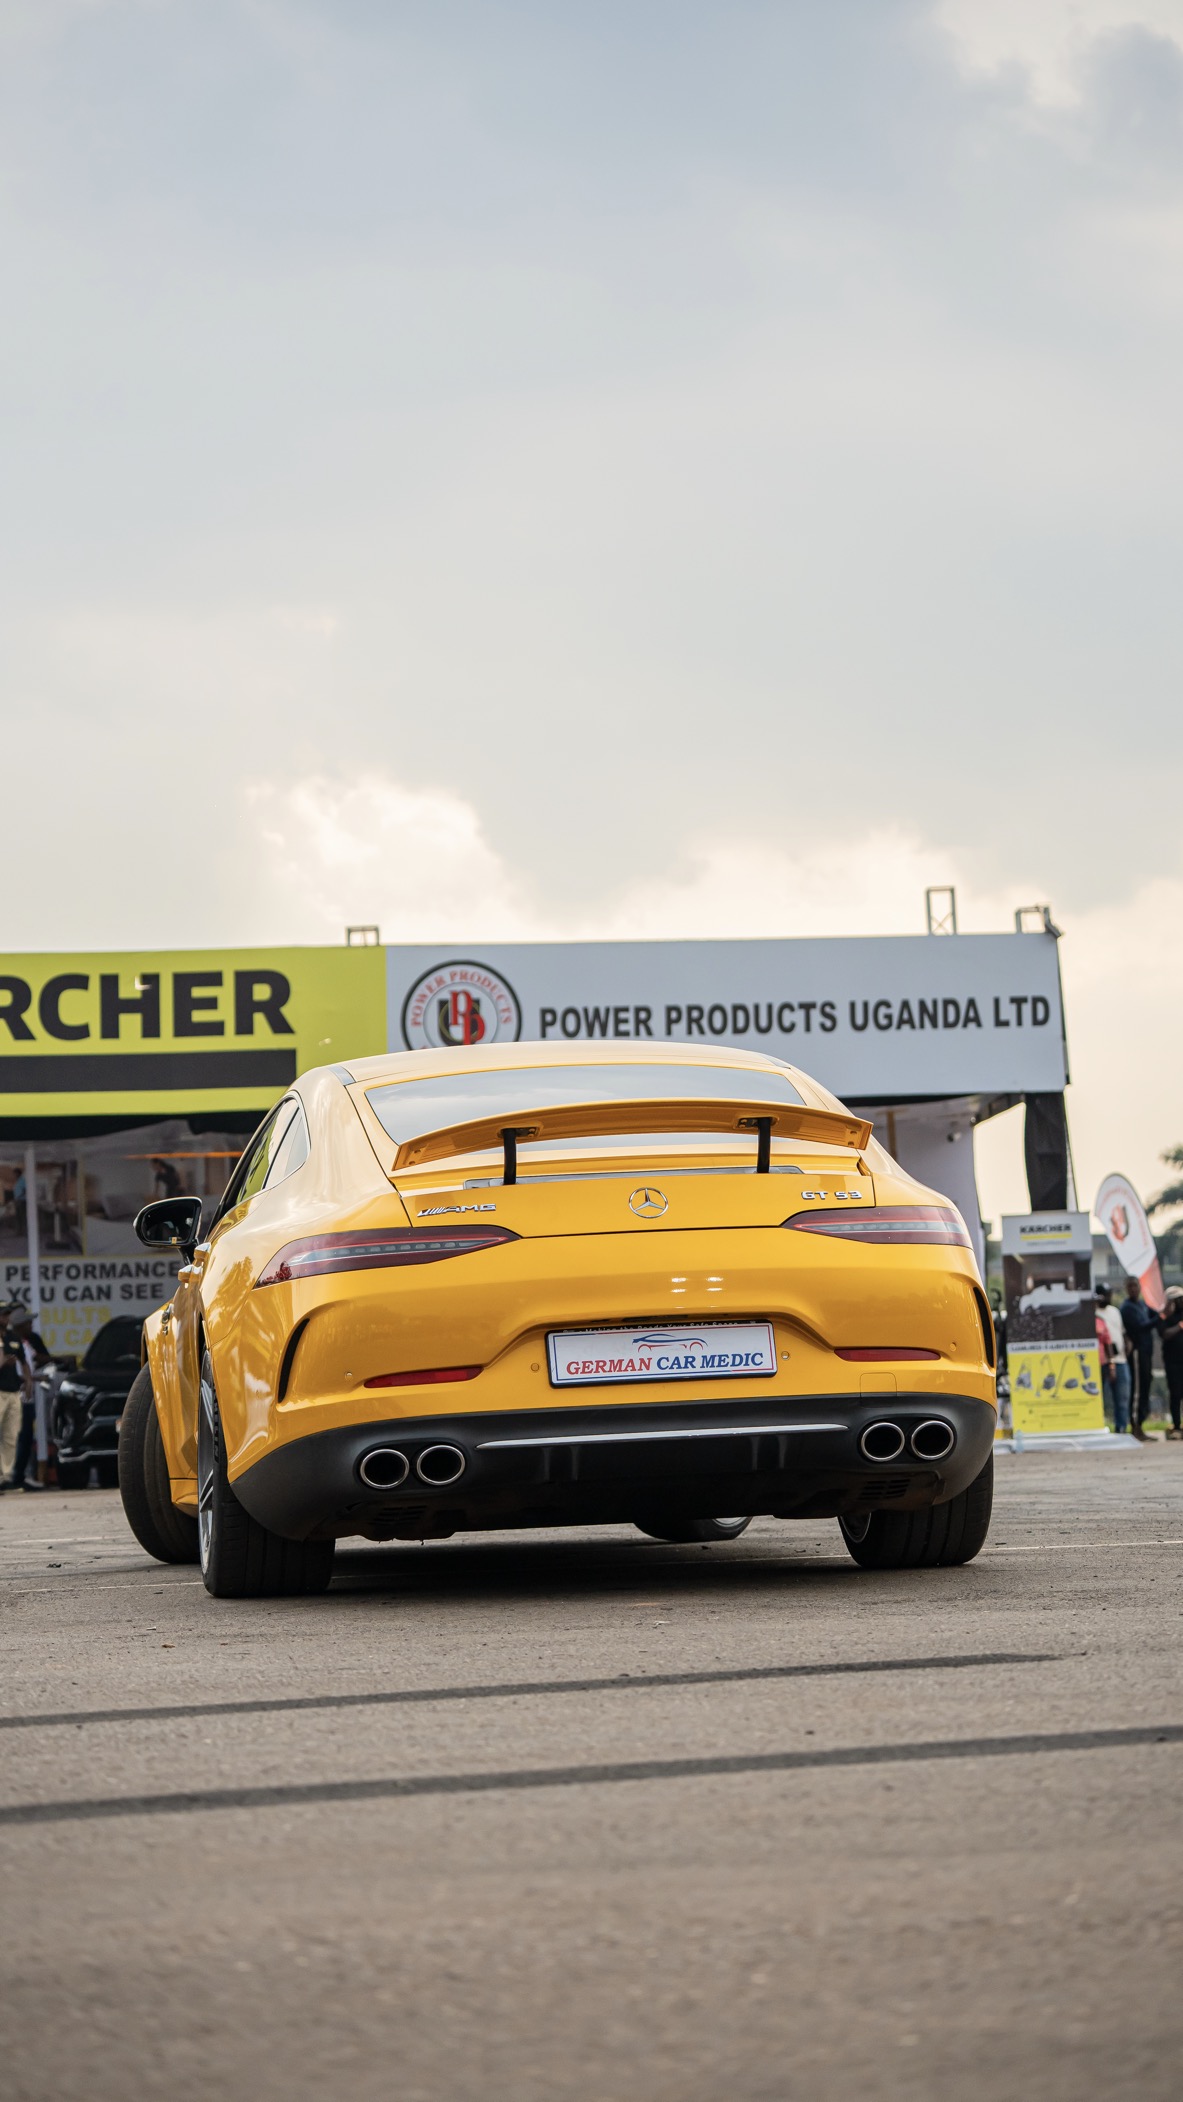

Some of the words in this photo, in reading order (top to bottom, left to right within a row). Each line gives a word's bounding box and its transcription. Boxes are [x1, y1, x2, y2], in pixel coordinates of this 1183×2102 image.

[0, 969, 296, 1041] RCHER
[411, 975, 446, 1028] POWER
[449, 970, 512, 1025] PRODUCTS
[540, 1006, 653, 1039] POWER
[665, 1001, 838, 1036] PRODUCTS
[849, 997, 983, 1031] UGANDA
[994, 995, 1050, 1028] LTD
[801, 1191, 828, 1200] GT
[834, 1190, 862, 1200] 53
[5, 1261, 181, 1282] PERFORMANCE
[8, 1286, 55, 1303] YOU
[64, 1284, 112, 1300] CAN
[120, 1283, 164, 1299] SEE
[566, 1358, 652, 1375] GERMAN
[656, 1355, 696, 1370] CAR
[700, 1352, 764, 1369] MEDIC
